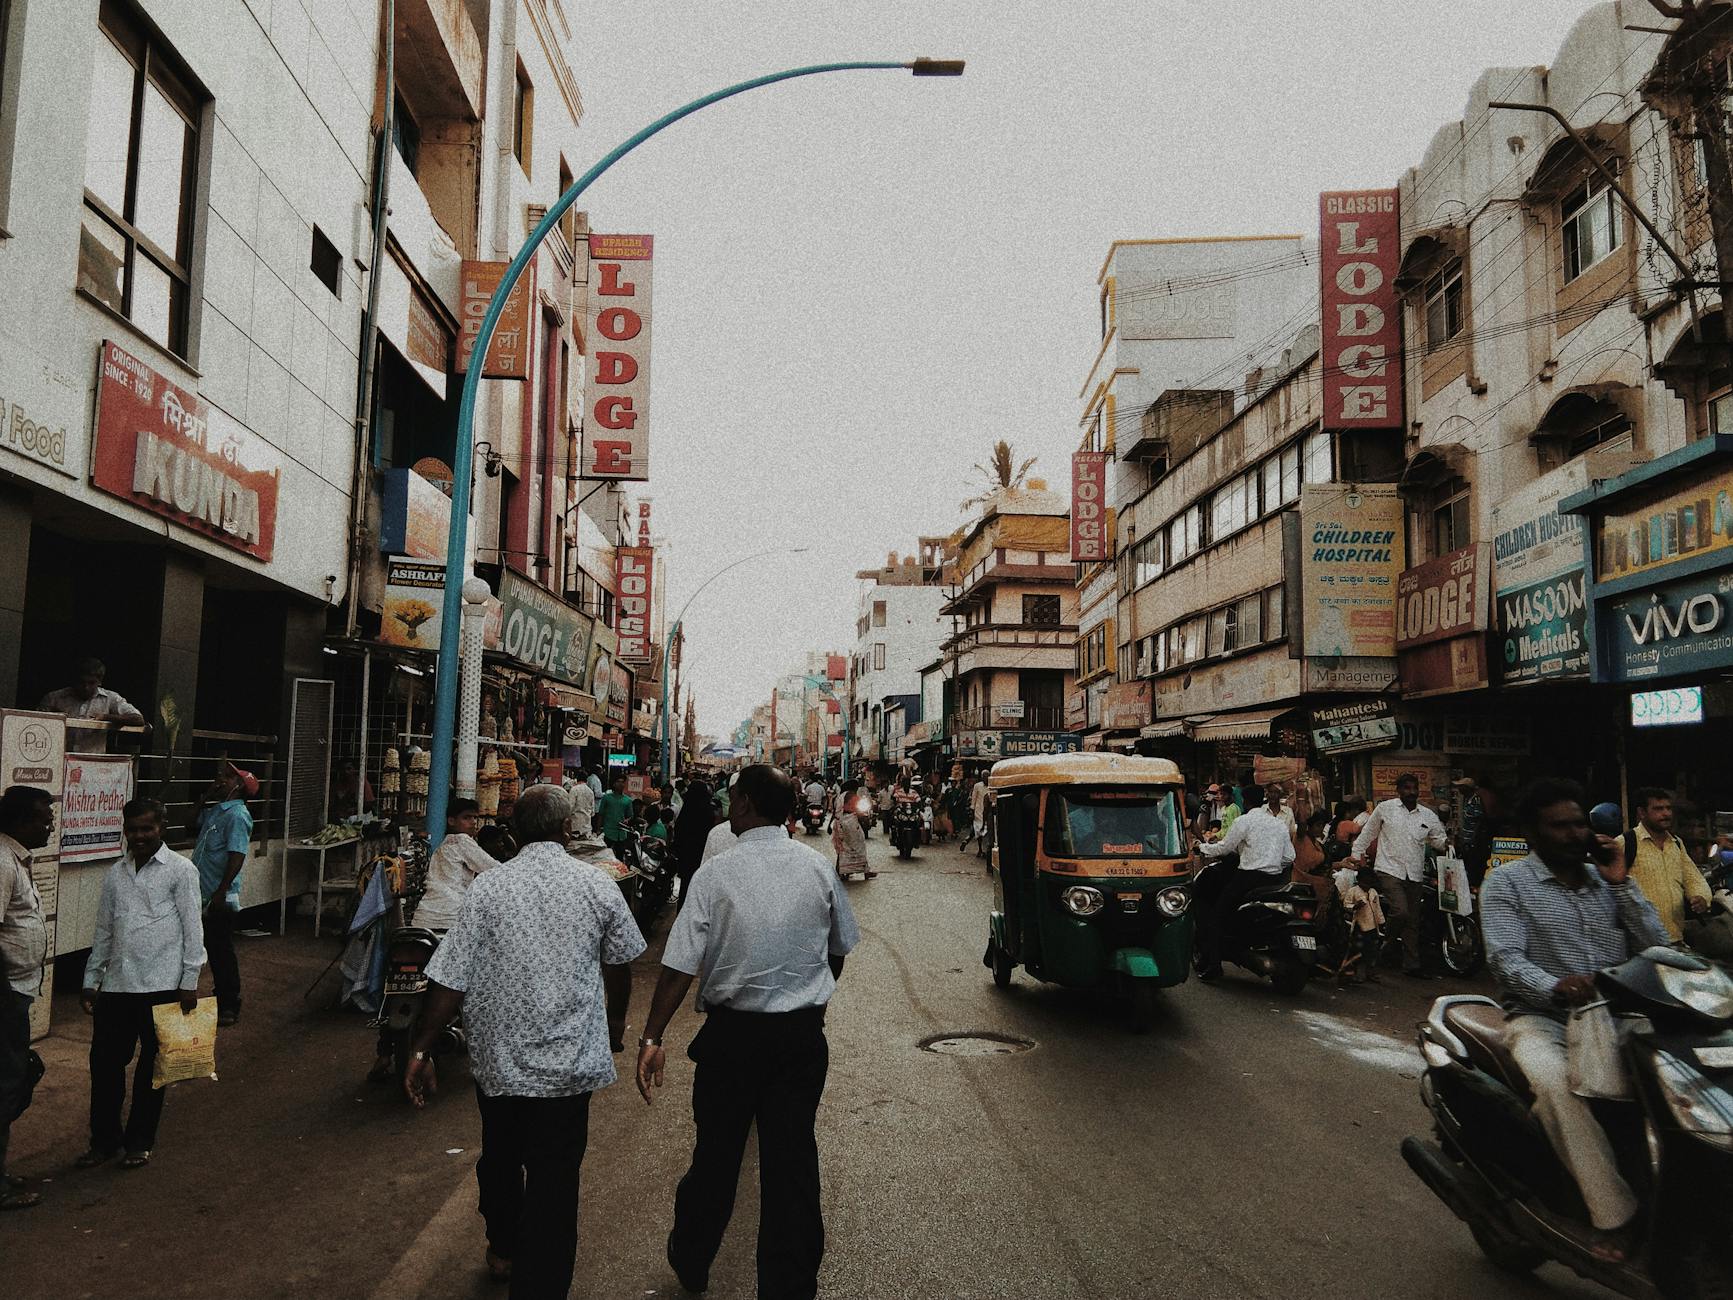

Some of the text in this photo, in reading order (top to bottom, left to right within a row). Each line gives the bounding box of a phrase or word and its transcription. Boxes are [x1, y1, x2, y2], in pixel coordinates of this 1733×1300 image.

[1326, 195, 1395, 213] CLASSIC
[1335, 220, 1389, 421] LODGE
[104, 361, 128, 388] SINCE
[111, 347, 149, 382] ORIGINAL
[592, 263, 643, 475] LODGE
[9, 402, 67, 466] Food
[132, 430, 260, 546] KUNDA
[1077, 463, 1101, 558] LODGE
[1311, 548, 1392, 562] HOSPITAL
[1312, 530, 1397, 545] CHILDREN
[1495, 519, 1537, 562] CHILDREN
[618, 555, 648, 656] LODGE
[1397, 573, 1473, 642] LODGE
[1505, 573, 1587, 633] MASOOM
[496, 608, 563, 673] ODGE
[1519, 622, 1581, 662] Medicals
[1625, 635, 1733, 665] Honesty Communicatio
[1312, 699, 1389, 722] Mahantesh
[23, 731, 48, 748] Pai
[1005, 741, 1082, 753] MEDICAS
[1028, 734, 1056, 742] AMAN
[65, 788, 125, 813] Mishra Pedha
